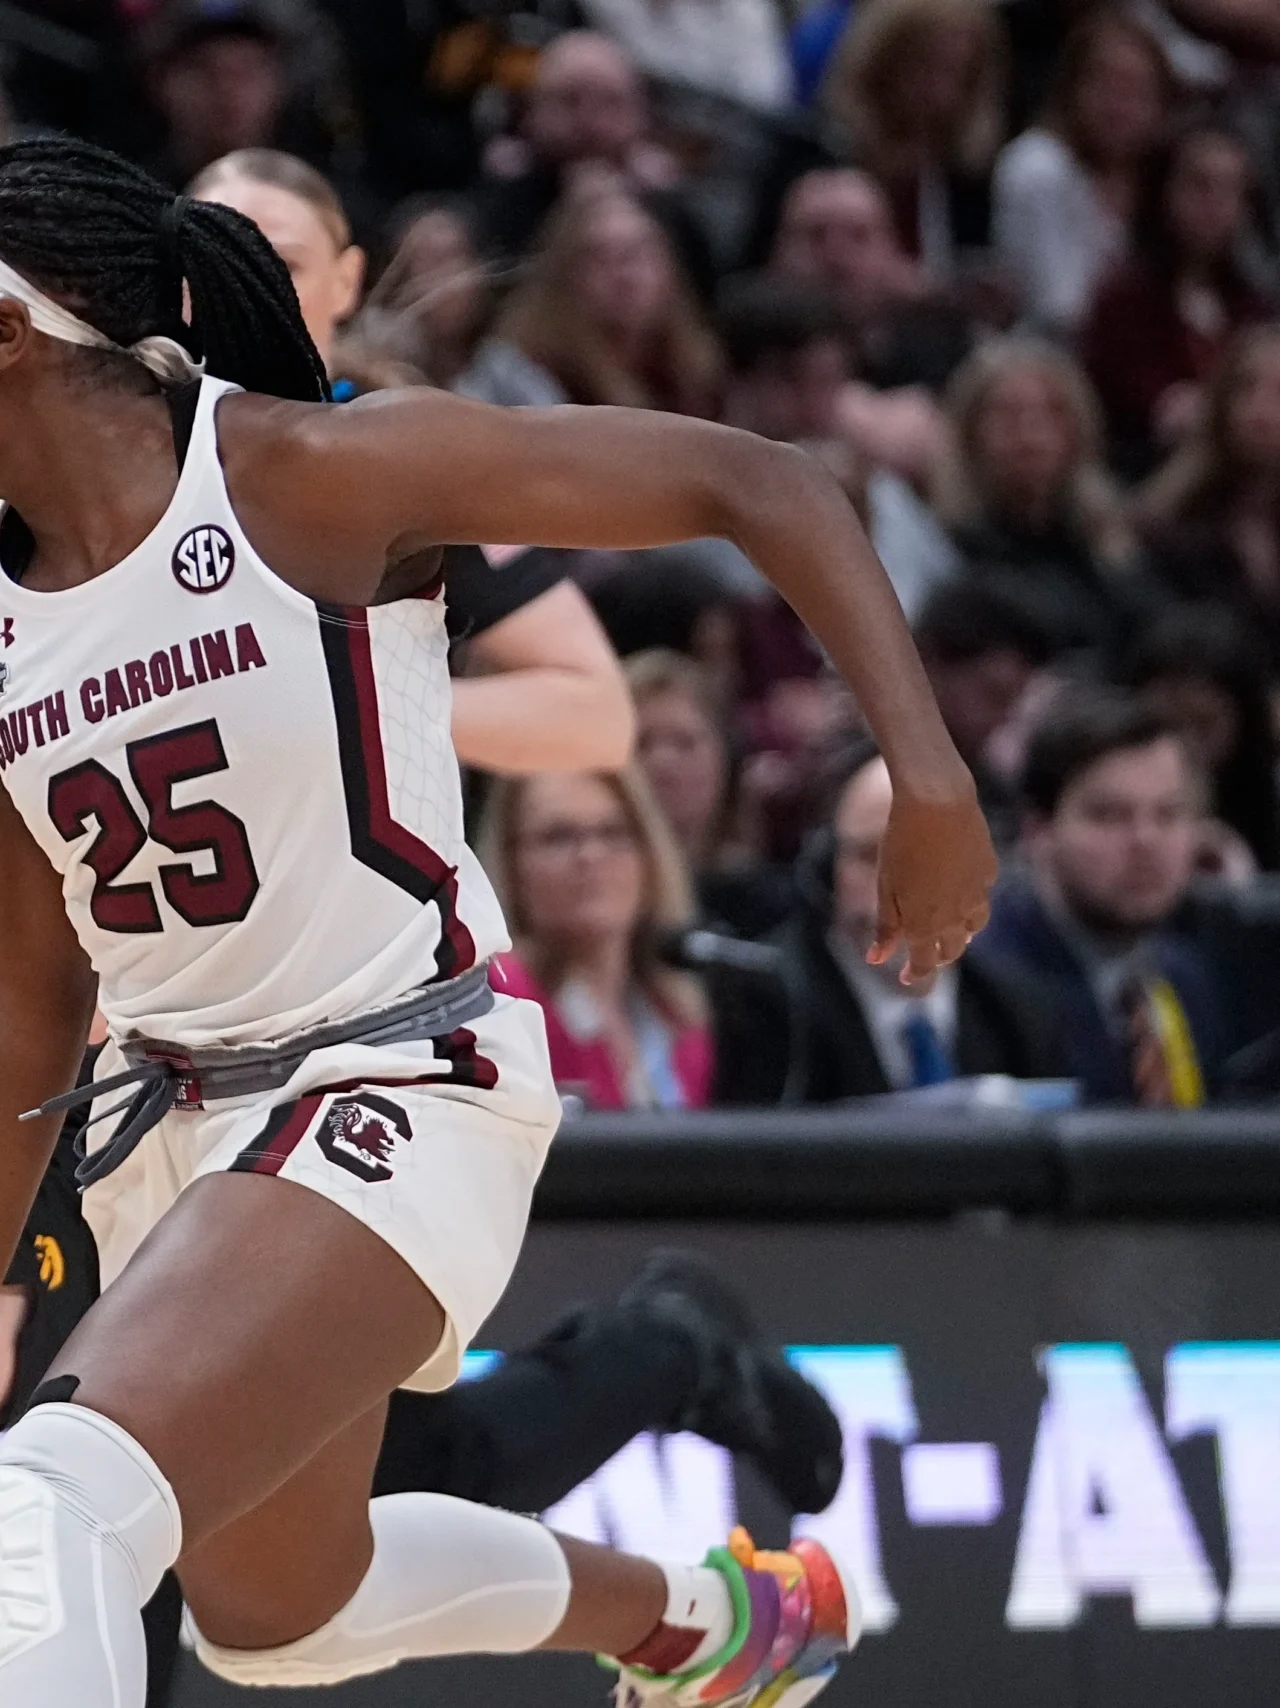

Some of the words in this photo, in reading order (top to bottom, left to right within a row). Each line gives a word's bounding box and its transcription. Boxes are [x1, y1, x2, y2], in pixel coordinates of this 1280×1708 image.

[177, 528, 230, 588] SEC
[79, 622, 267, 724] CAROLINA
[48, 717, 260, 934] 25
